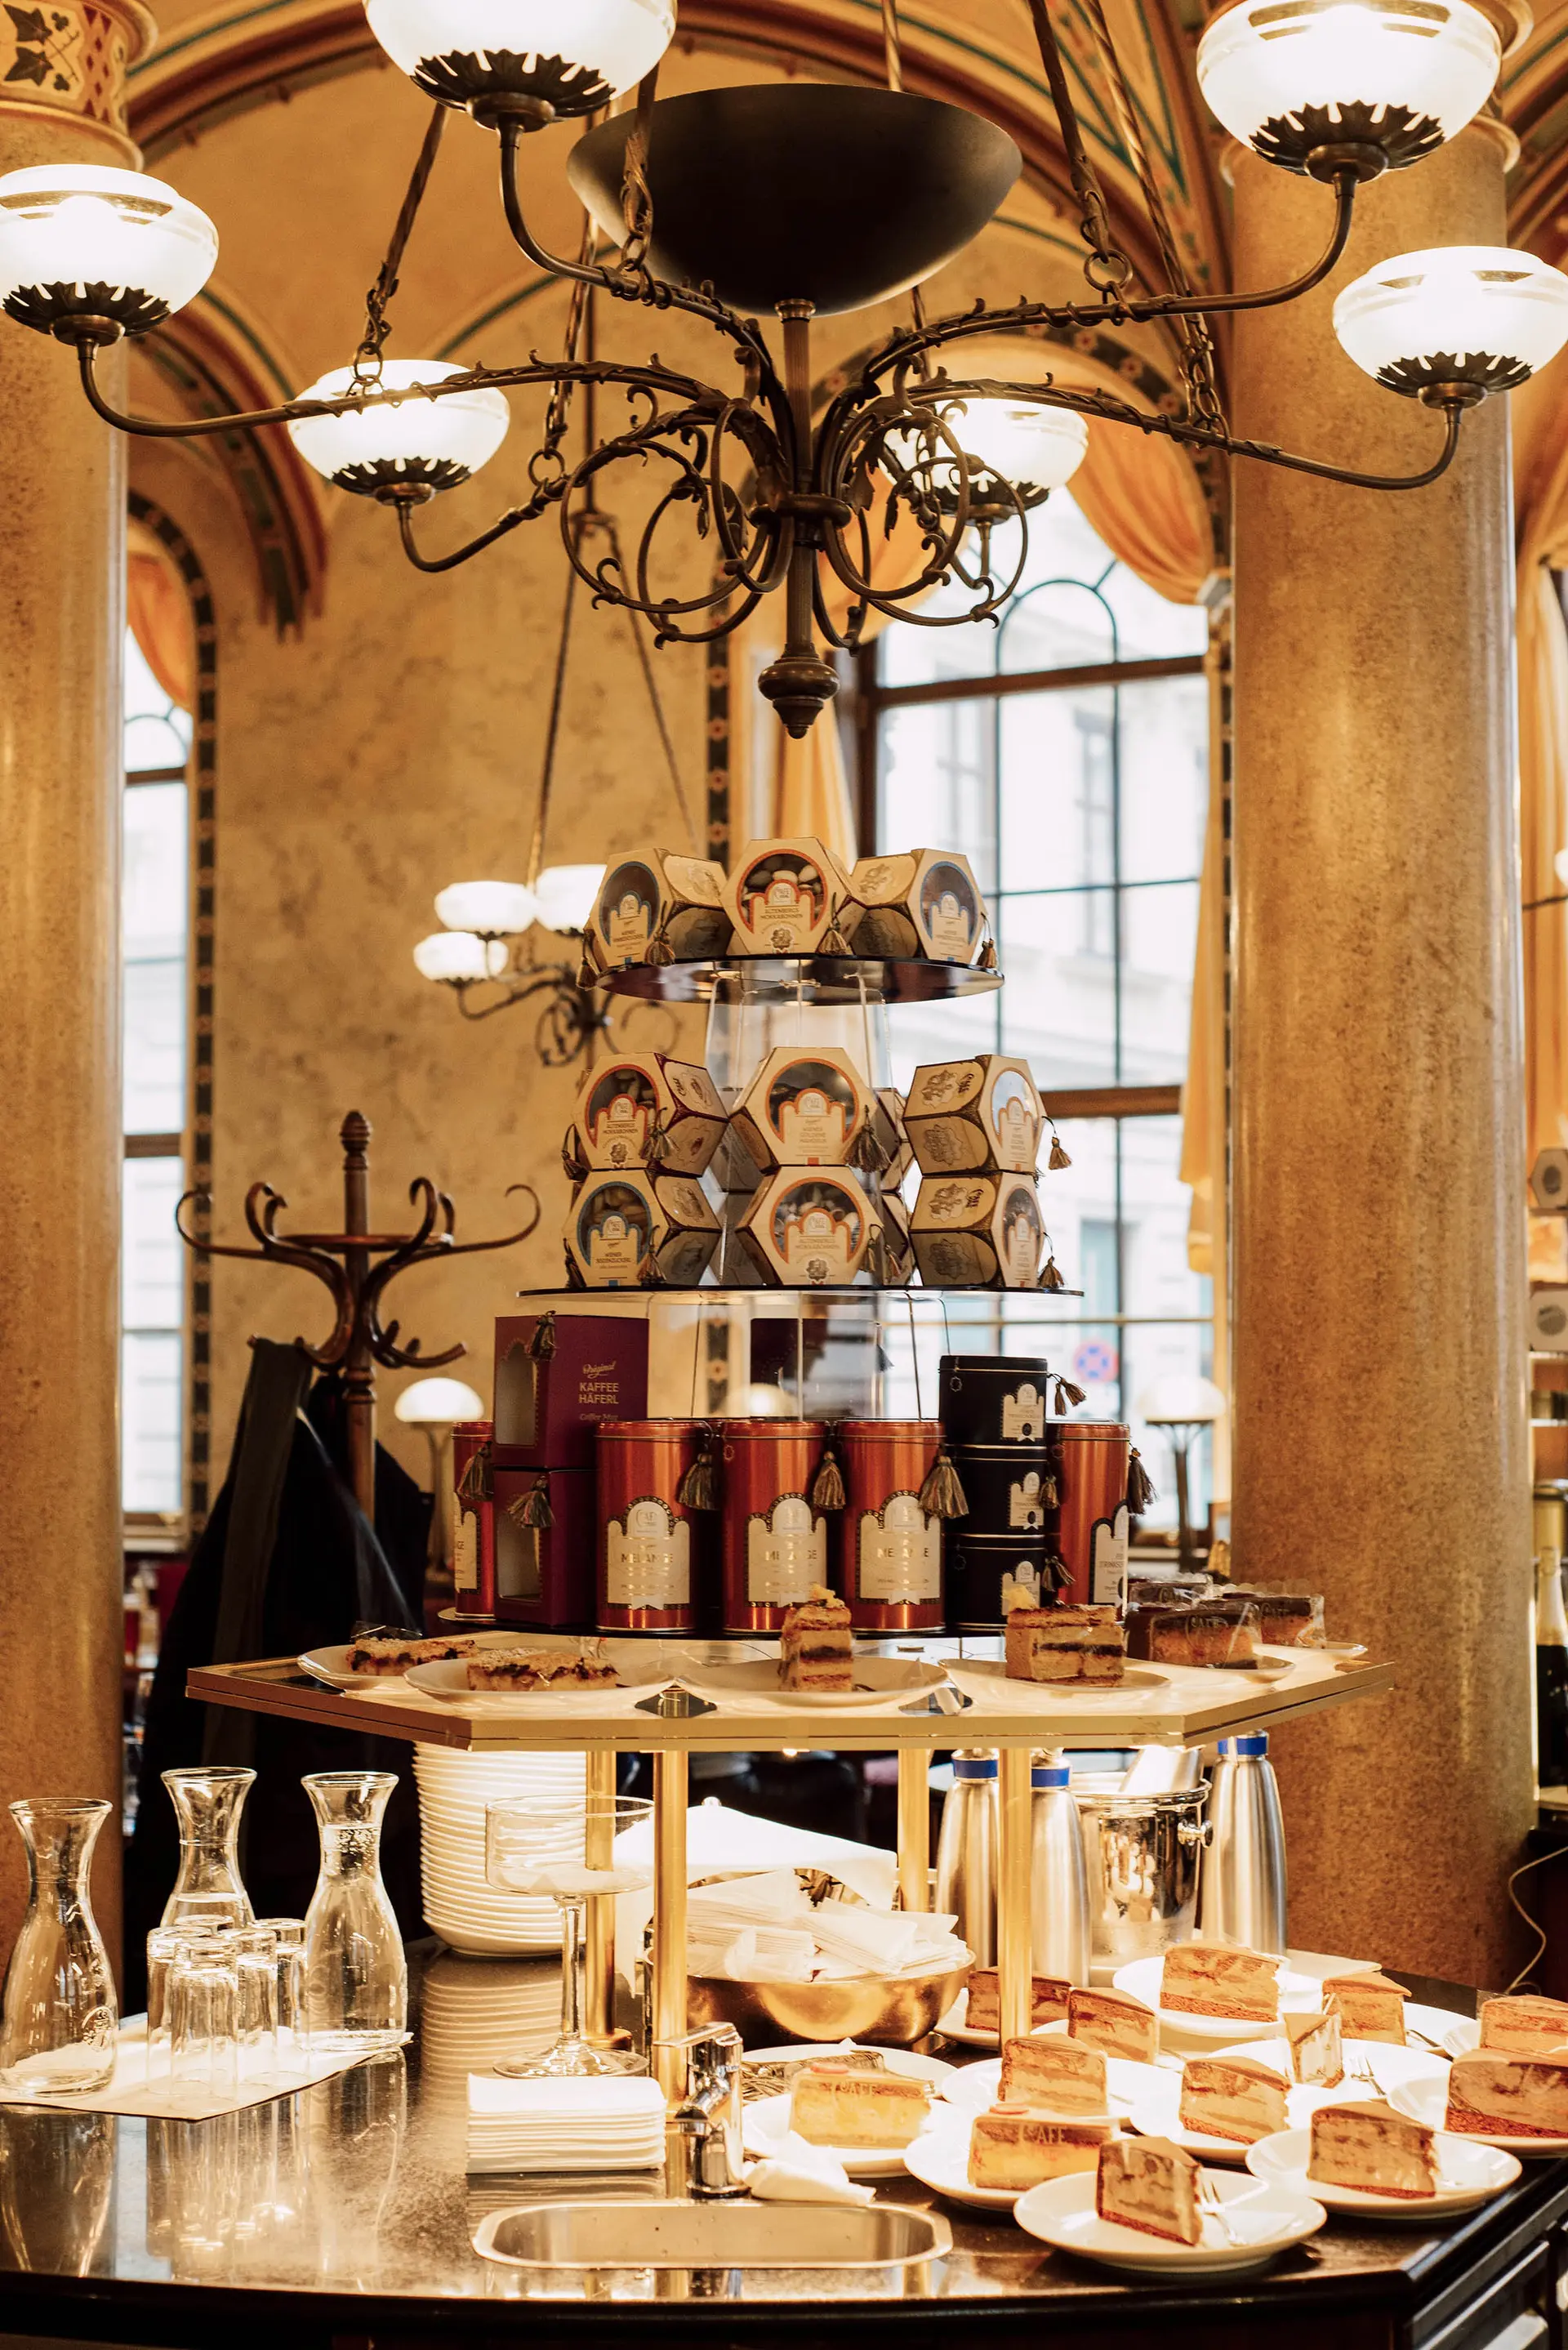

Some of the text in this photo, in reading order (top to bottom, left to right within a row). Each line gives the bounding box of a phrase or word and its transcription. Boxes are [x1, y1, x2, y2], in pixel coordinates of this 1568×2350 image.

[582, 1360, 617, 1380] Original
[578, 1382, 619, 1393] KAFFEE
[1018, 2121, 1067, 2146] CAFE
